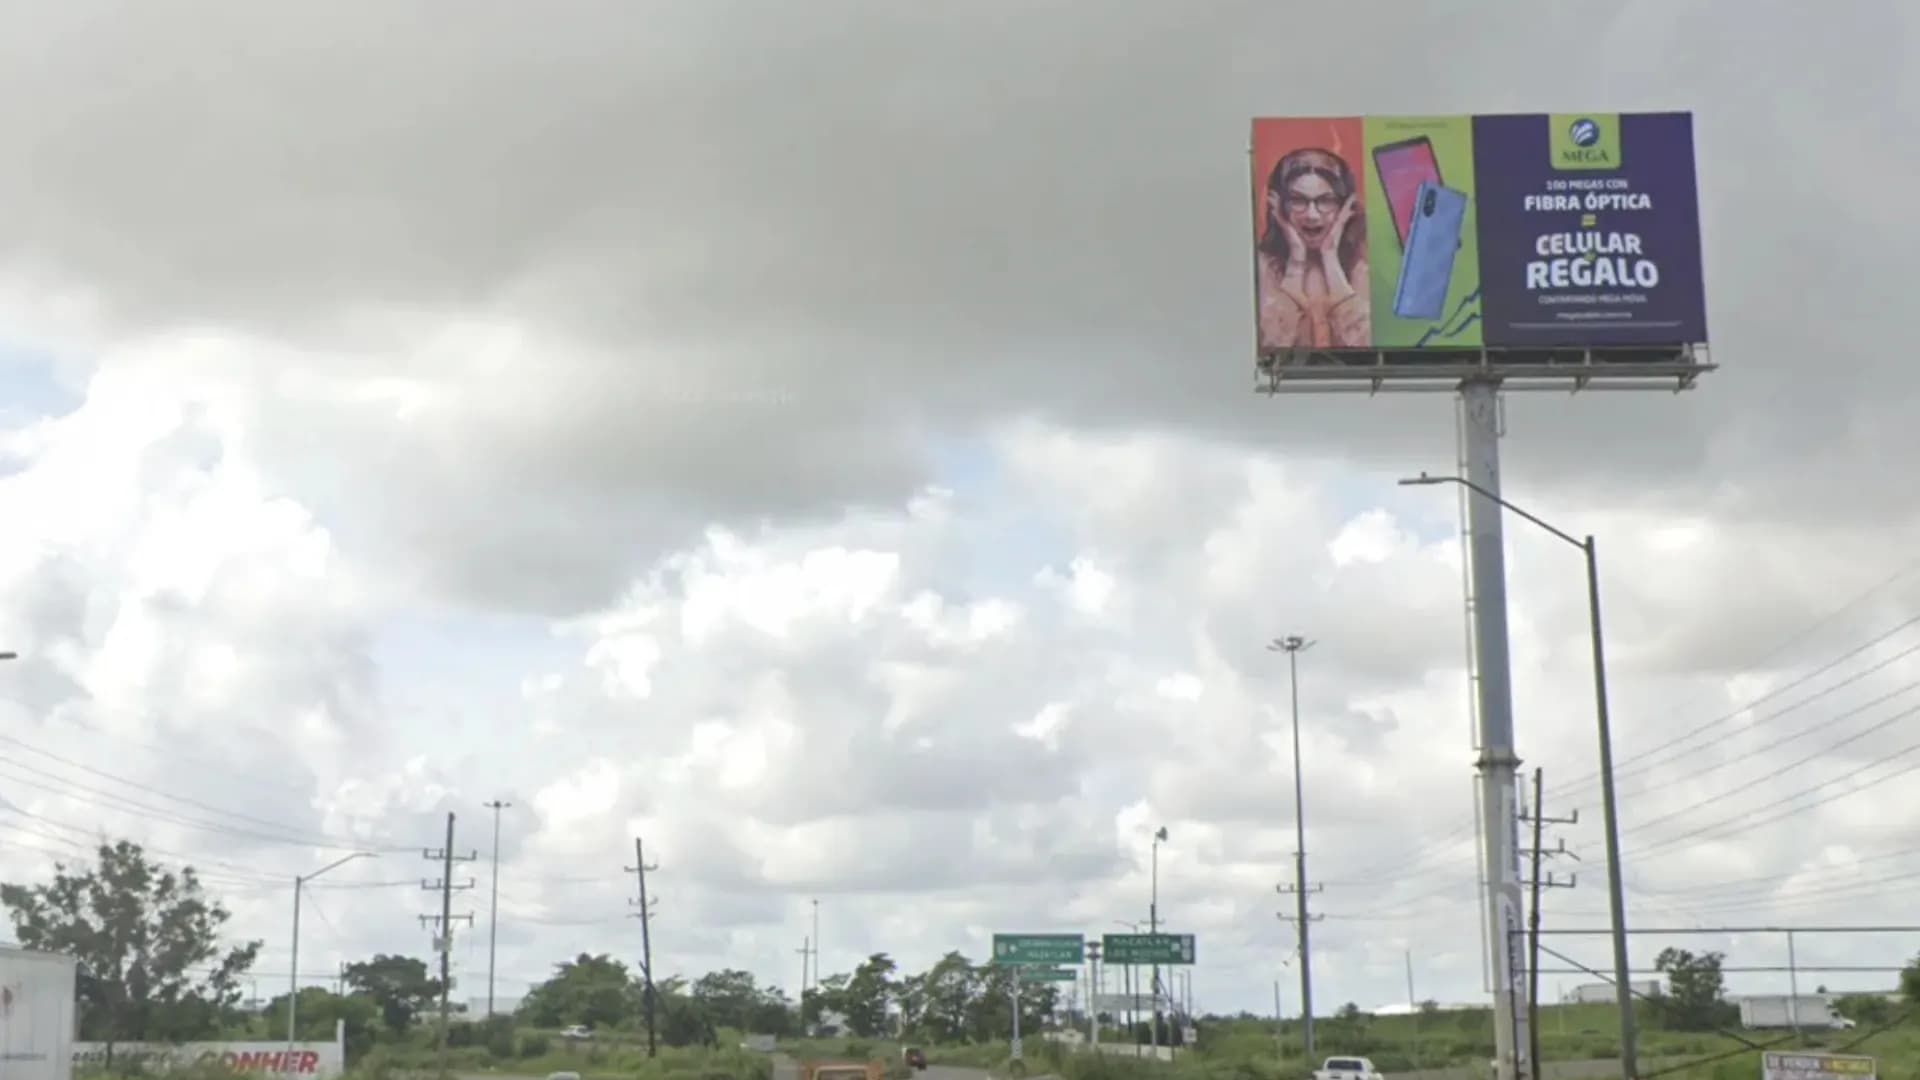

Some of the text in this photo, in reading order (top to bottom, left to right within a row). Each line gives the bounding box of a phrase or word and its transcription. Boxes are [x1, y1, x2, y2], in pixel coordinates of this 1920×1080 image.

[1562, 149, 1609, 162] MEGA
[1546, 178, 1628, 190] 100 MEGAS CON
[1525, 192, 1651, 211] FIBRA ÓPTICA
[1536, 231, 1642, 255] CELULAR
[1526, 257, 1659, 289] REGALO
